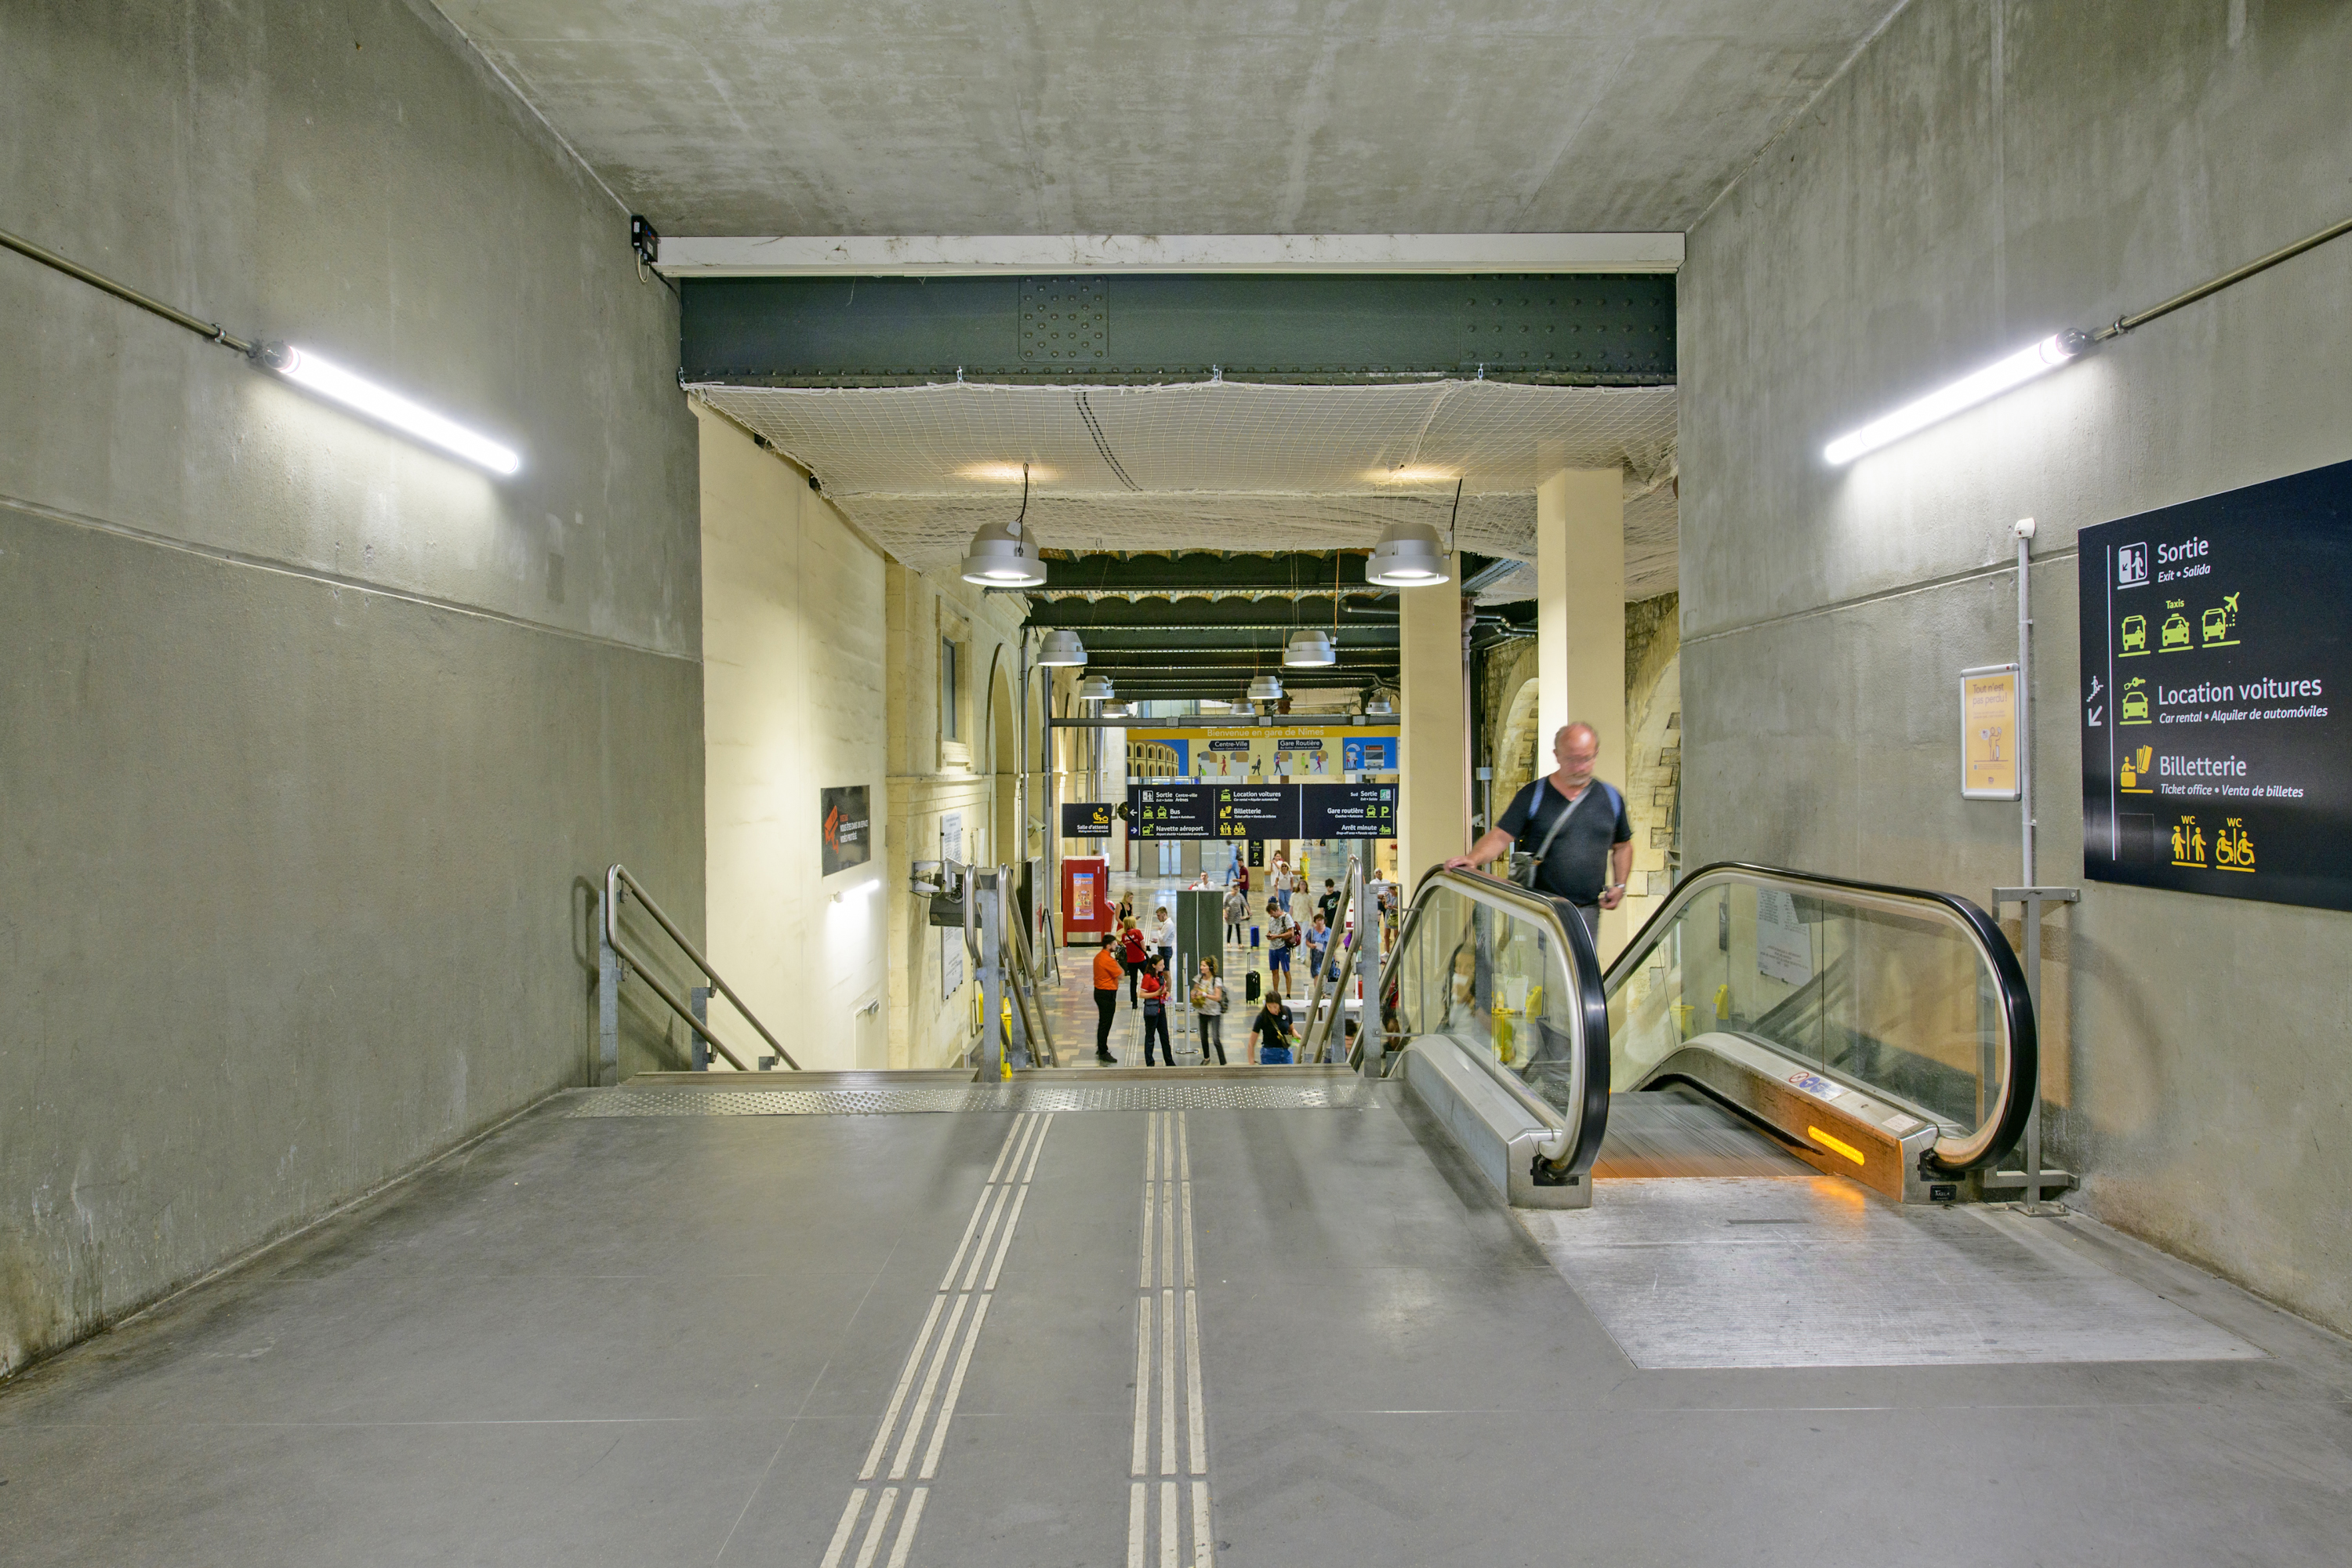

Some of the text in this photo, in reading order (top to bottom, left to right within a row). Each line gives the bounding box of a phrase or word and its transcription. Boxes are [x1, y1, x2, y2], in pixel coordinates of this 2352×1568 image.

[2158, 536, 2209, 564] Sortie
[2158, 563, 2211, 583] Exit Salida
[2165, 599, 2184, 609] Taxis
[1973, 684, 1987, 694] Tout
[2158, 677, 2322, 705] Location voitures
[1973, 697, 1984, 708] pas
[2159, 705, 2328, 724] Car rental Alquiler de automóviles
[1207, 728, 1250, 737] Bienvenue
[1264, 729, 1283, 739] gare
[1285, 728, 1296, 736] de
[1298, 727, 1324, 735] Nîmes
[2159, 755, 2247, 776] Billetterie
[2161, 784, 2304, 798] Ticket office Venta de billetes
[2181, 815, 2195, 825] WC
[2227, 818, 2242, 828] WC
